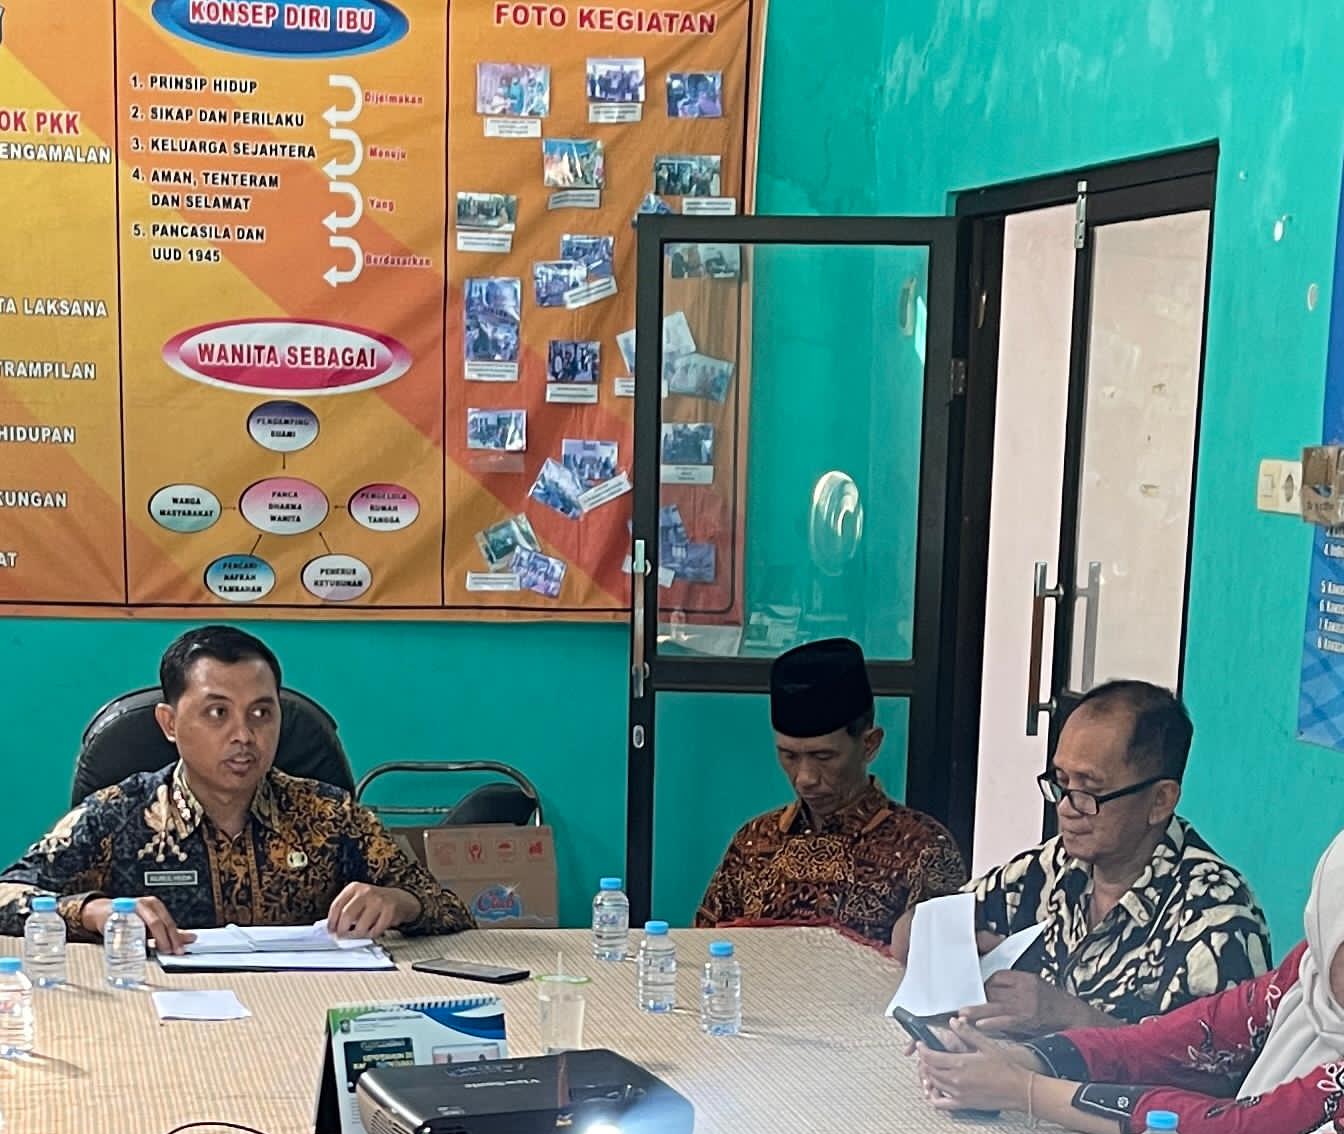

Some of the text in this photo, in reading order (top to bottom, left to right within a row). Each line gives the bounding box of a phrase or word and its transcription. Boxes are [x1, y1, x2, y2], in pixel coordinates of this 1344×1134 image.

[191, 1, 374, 31] KONSEP DIRI IBU
[495, 4, 716, 34] FOTO KEGIATAN
[150, 76, 257, 94] PRINSIP HIDUP
[36, 112, 80, 135] PKK
[151, 107, 304, 127] SIKAP DAN PERILAKU
[151, 139, 316, 159] KELUARGA SEJAHTERA
[369, 147, 406, 161] Menuju
[151, 170, 279, 188] AMAN, TENTERAM
[151, 194, 250, 210] DAN SELAMAT
[369, 199, 395, 212] Yang
[152, 224, 264, 241] PANCASILA DAN
[152, 248, 220, 263] UUD 1945
[24, 299, 107, 317] LAKSANA
[197, 343, 377, 370] WANITA SEBAGAI
